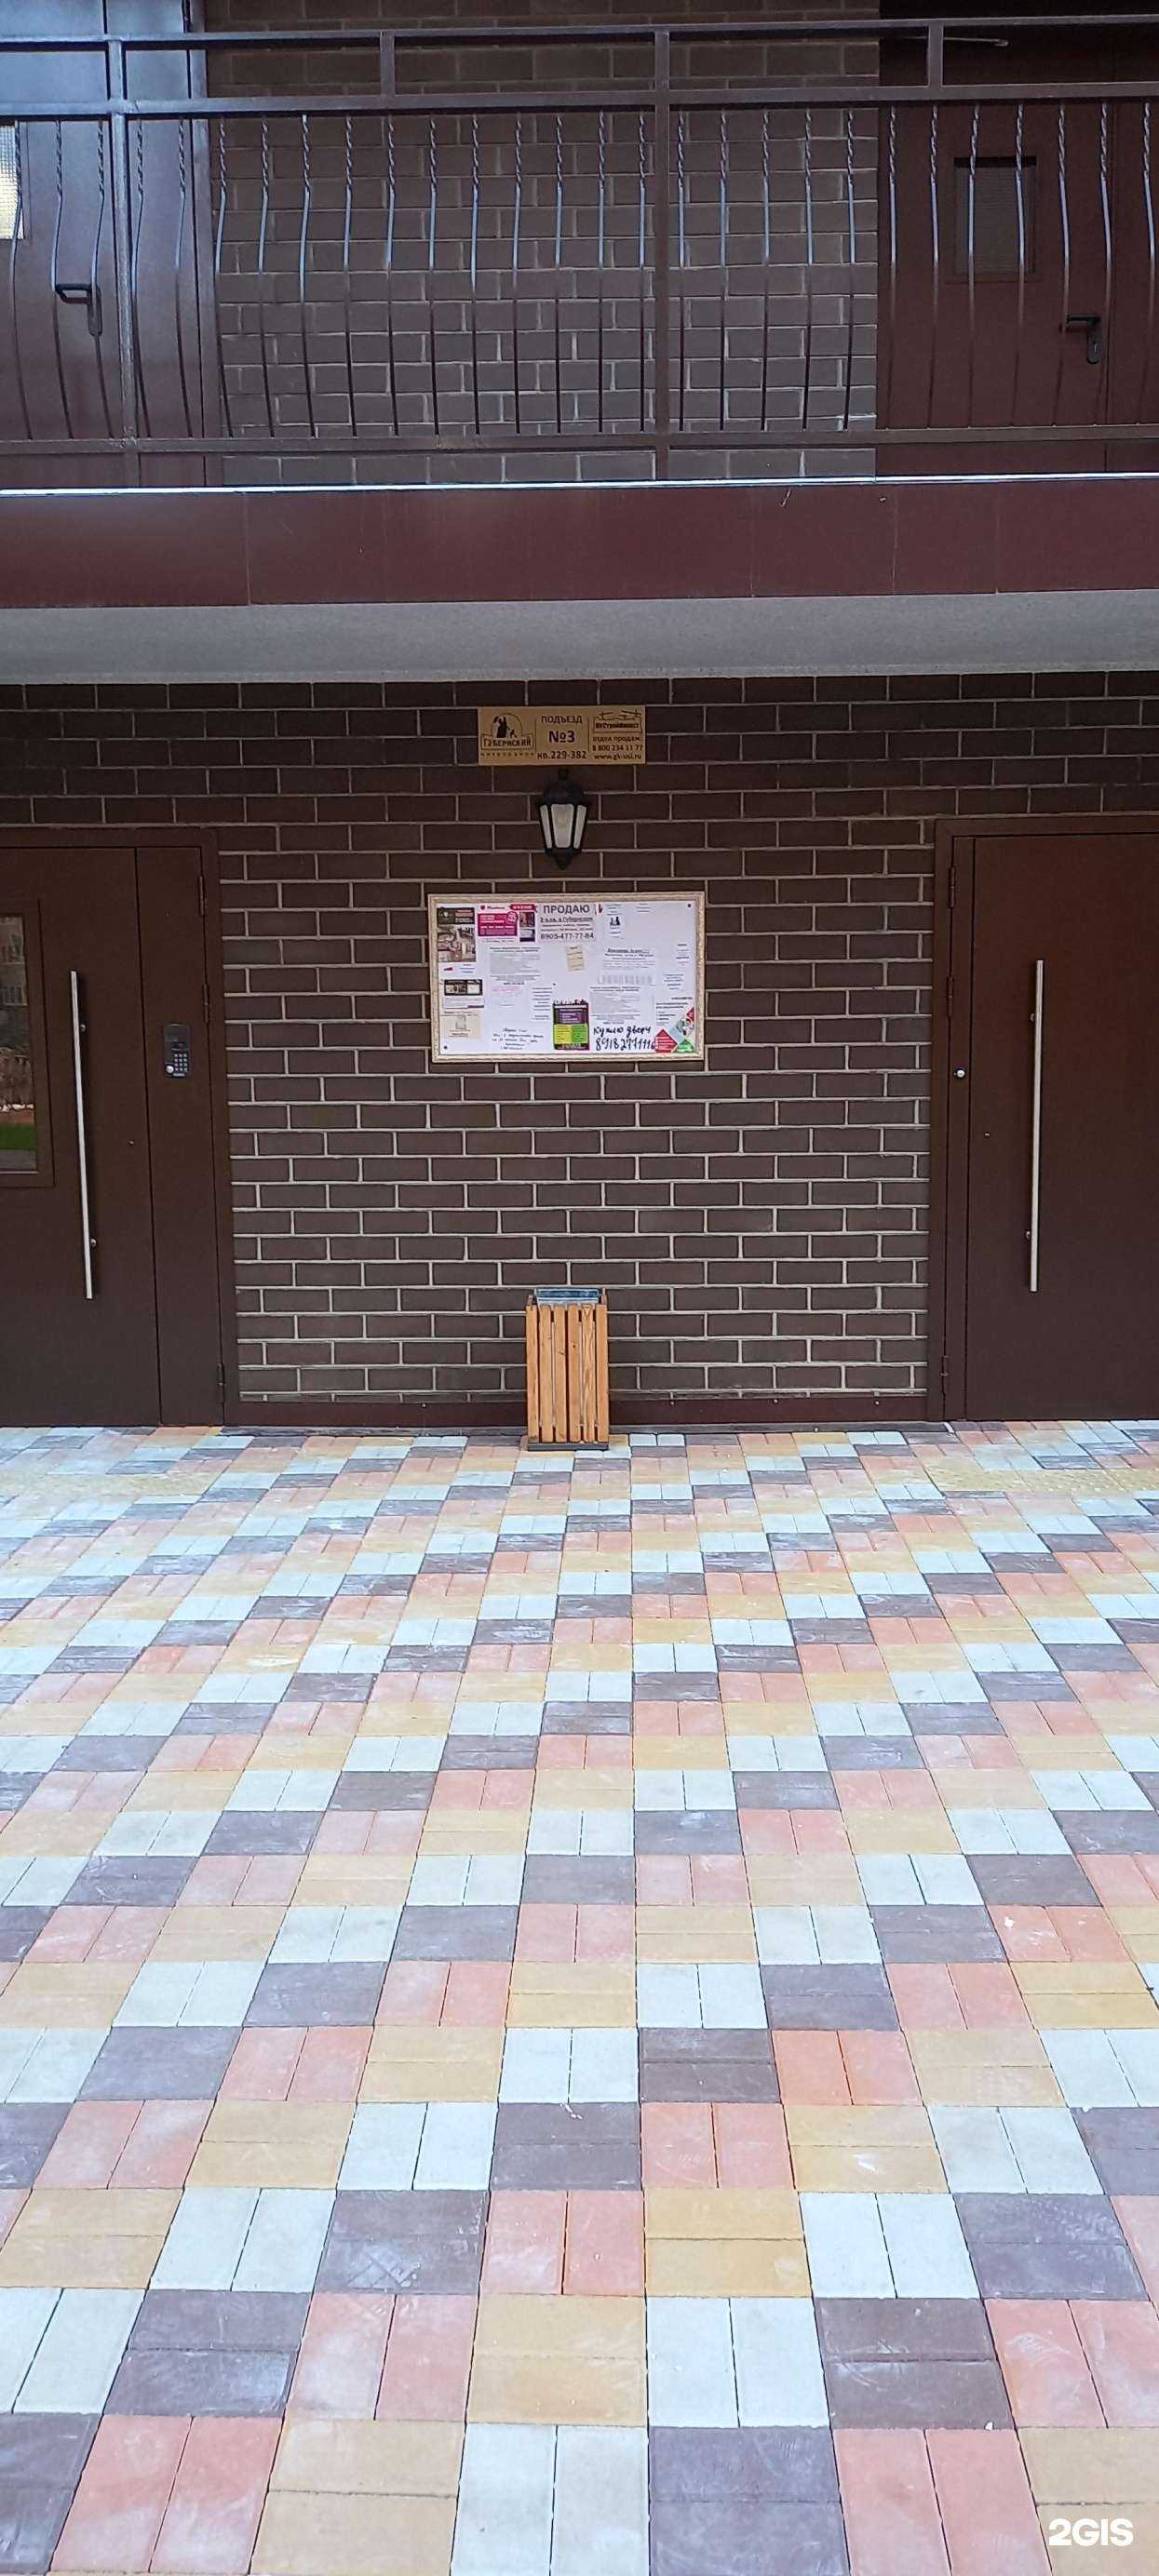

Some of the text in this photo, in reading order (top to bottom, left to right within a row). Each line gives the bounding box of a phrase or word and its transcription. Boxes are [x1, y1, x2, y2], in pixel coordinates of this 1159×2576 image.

[541, 715, 583, 724] ПОДЪЕЗД
[483, 736, 532, 747] ГУБЕРНСКИЙ
[548, 730, 575, 743] №3
[537, 750, 587, 759] кв.229-382
[543, 905, 590, 915] ПРОДАЮ
